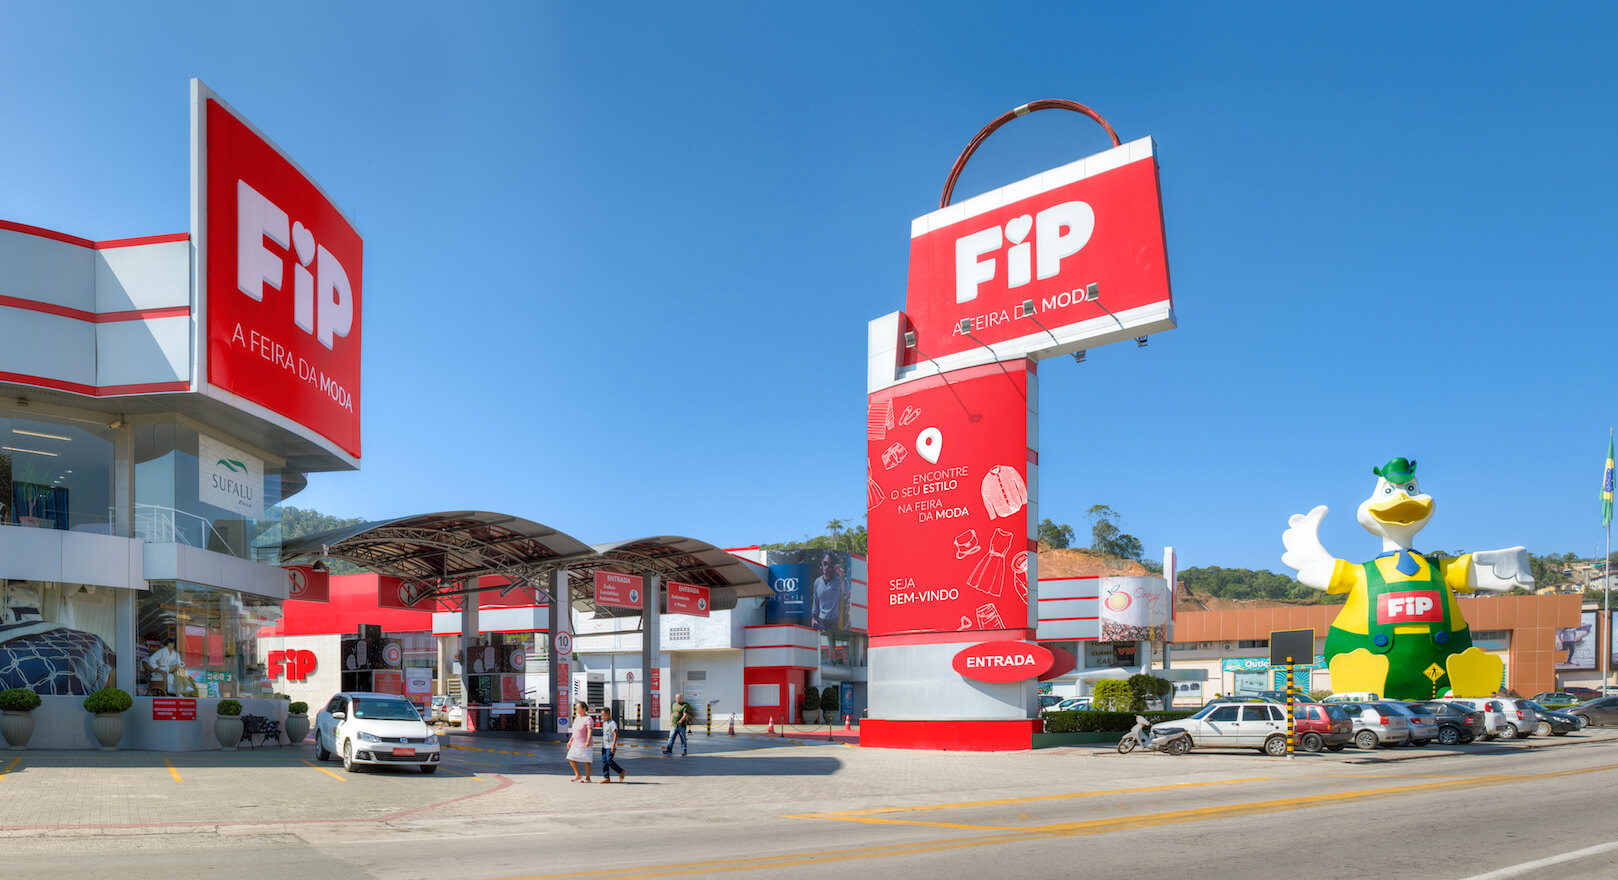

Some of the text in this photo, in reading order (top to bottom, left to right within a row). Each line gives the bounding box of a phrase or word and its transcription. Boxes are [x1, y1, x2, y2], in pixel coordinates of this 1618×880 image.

[955, 200, 1095, 304] FiP
[237, 178, 354, 350] FiP
[1041, 288, 1088, 312] MOD
[232, 322, 353, 414] A FEIRA DA MODA
[913, 465, 968, 485] ENCONTRE
[211, 473, 253, 501] SUFALU
[890, 479, 957, 500] O SEU ESTILO
[898, 498, 943, 514] NA FEIRA
[919, 506, 969, 523] DA MODA
[607, 574, 631, 584] ENTRADA
[889, 577, 916, 591] SEJA
[678, 585, 700, 594] ENTRADA
[889, 588, 960, 605] BEM-VINDO
[1388, 596, 1433, 617] FiP
[558, 635, 569, 647] 10
[1118, 647, 1137, 655] VIP
[267, 648, 317, 681] FiP
[966, 653, 1036, 668] ENTRADA
[1244, 658, 1270, 668] Outle
